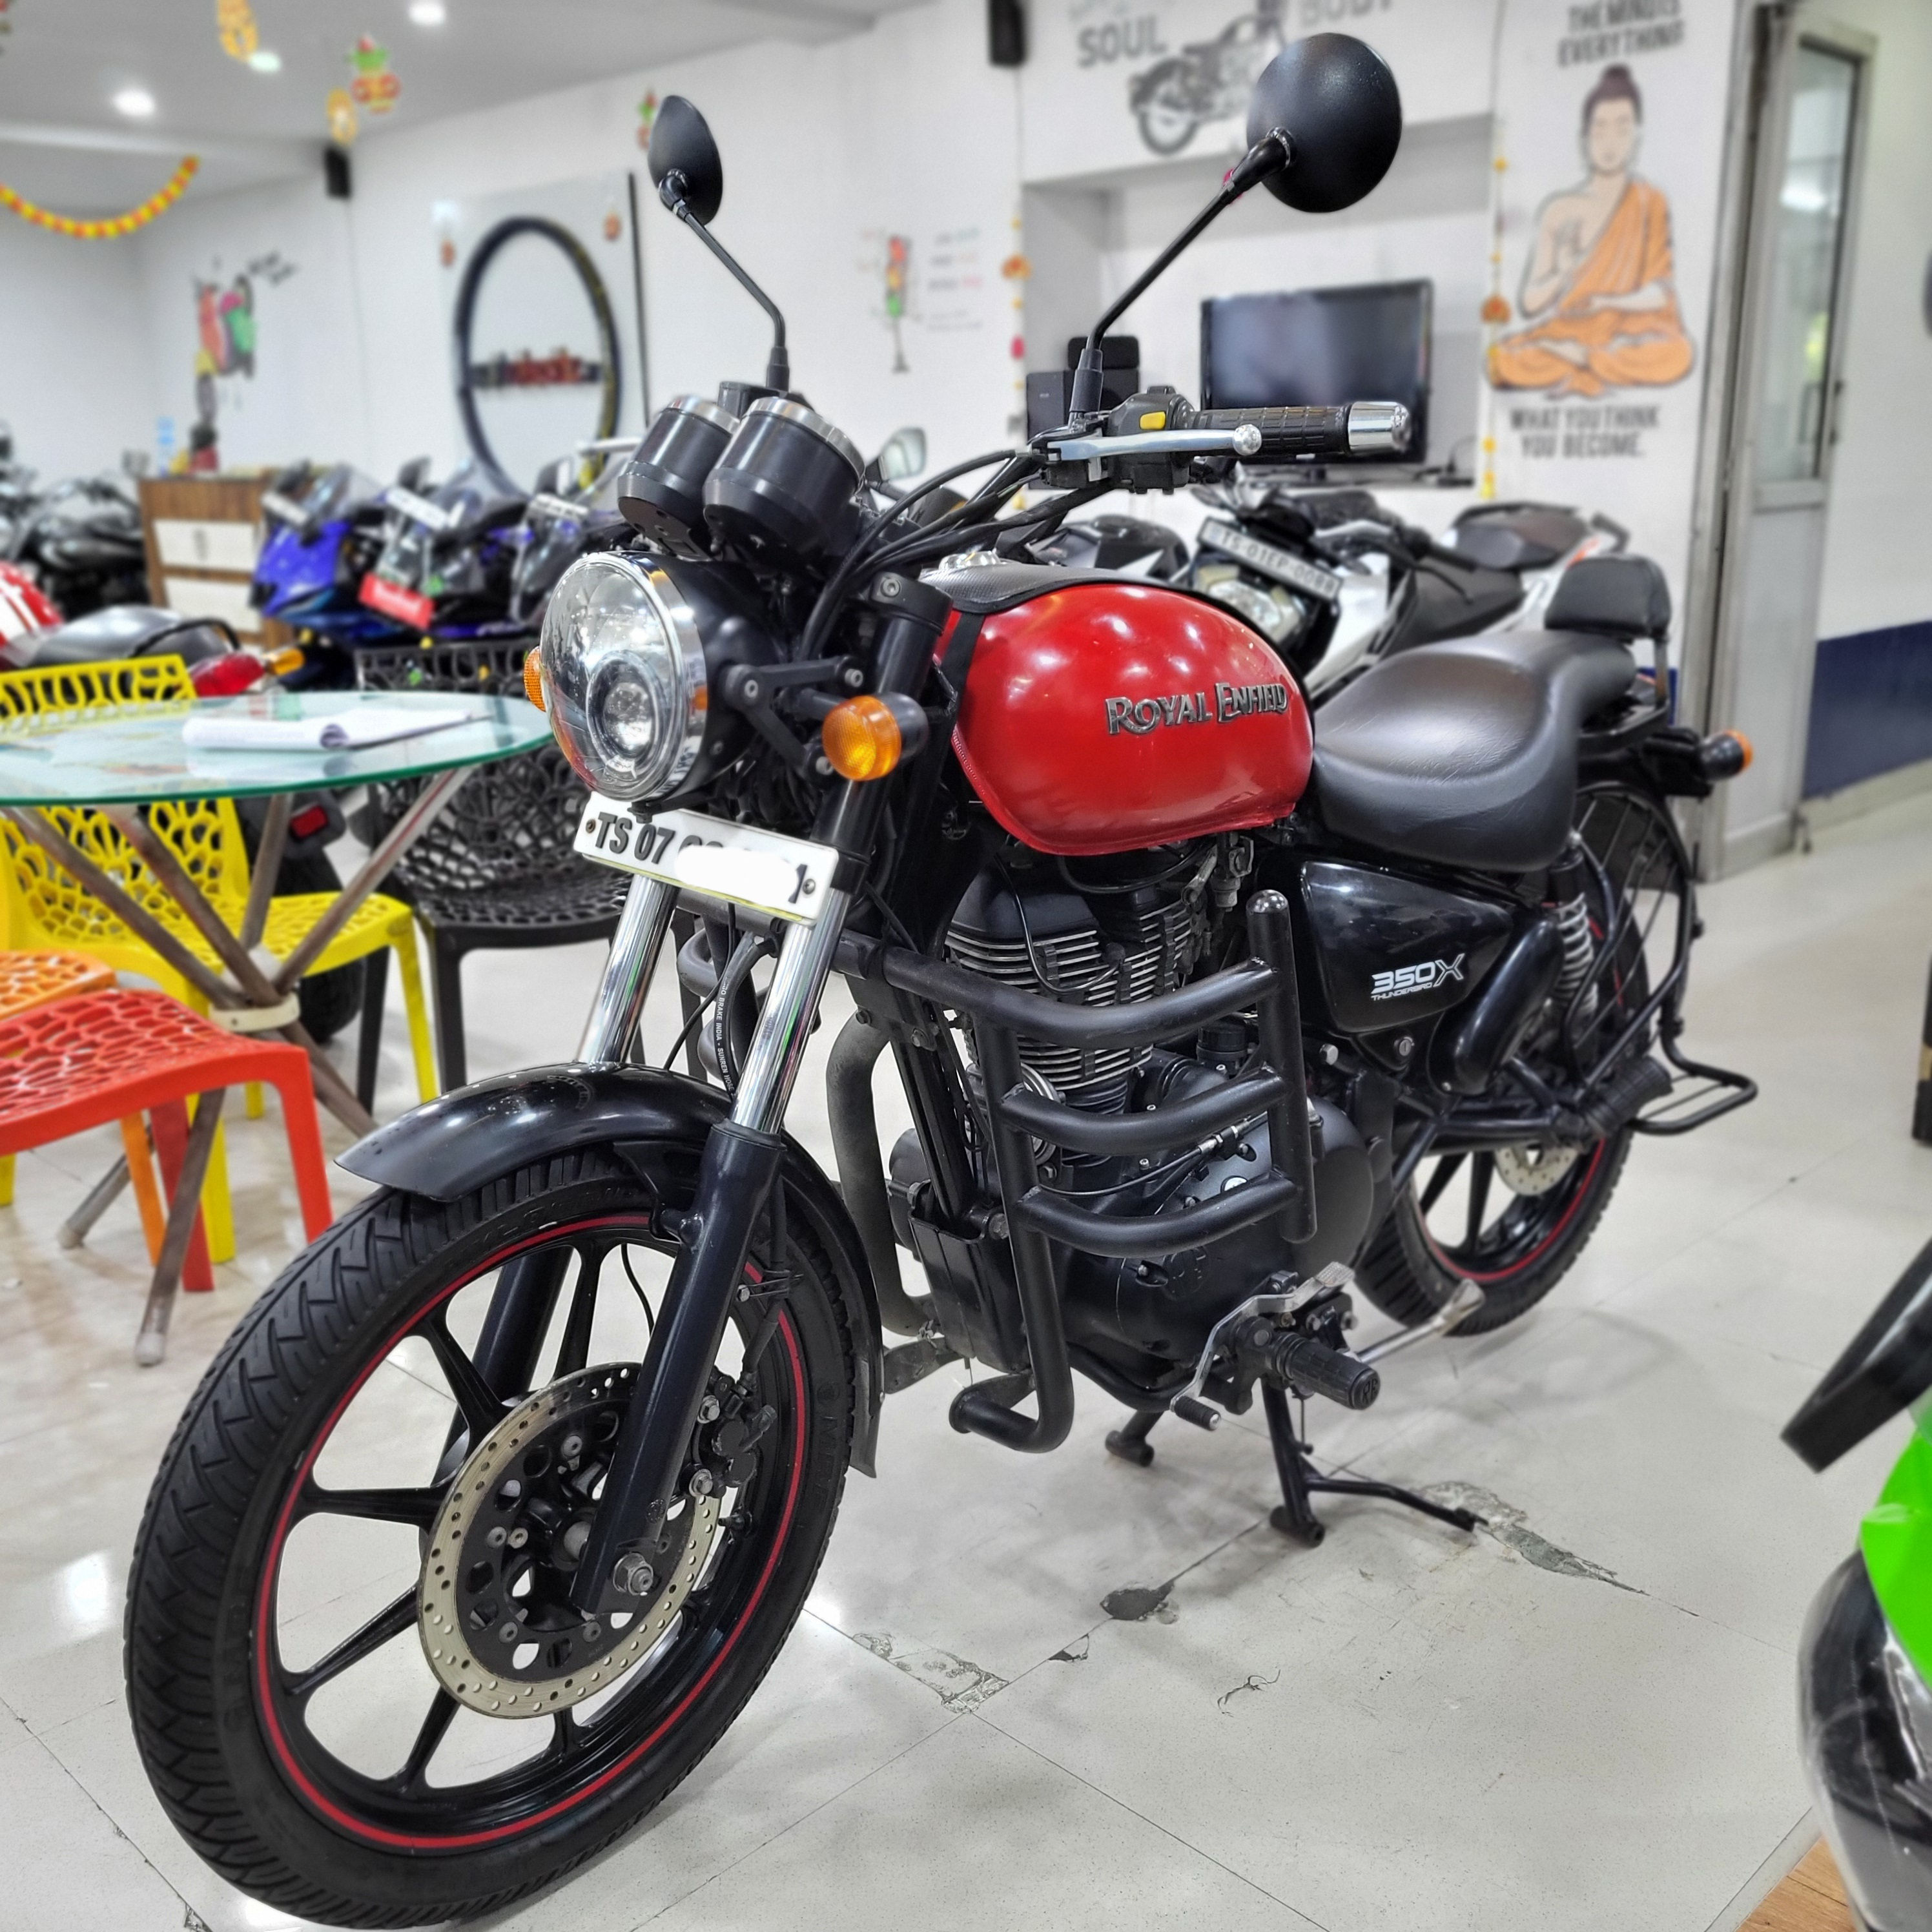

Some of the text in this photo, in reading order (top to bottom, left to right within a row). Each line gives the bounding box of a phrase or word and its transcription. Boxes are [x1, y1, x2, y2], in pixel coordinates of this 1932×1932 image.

[1300, 0, 1393, 27] BO
[1568, 2, 1601, 31] THE
[1077, 13, 1167, 68] SOUL
[1510, 403, 1661, 431] WHAT YOU THINK
[1521, 434, 1557, 458] YOU
[1105, 682, 1289, 735] ROYAL ENFIELD
[595, 812, 676, 865] TS 07
[1370, 952, 1466, 994] 350X
[715, 997, 725, 1021] BRAKE
